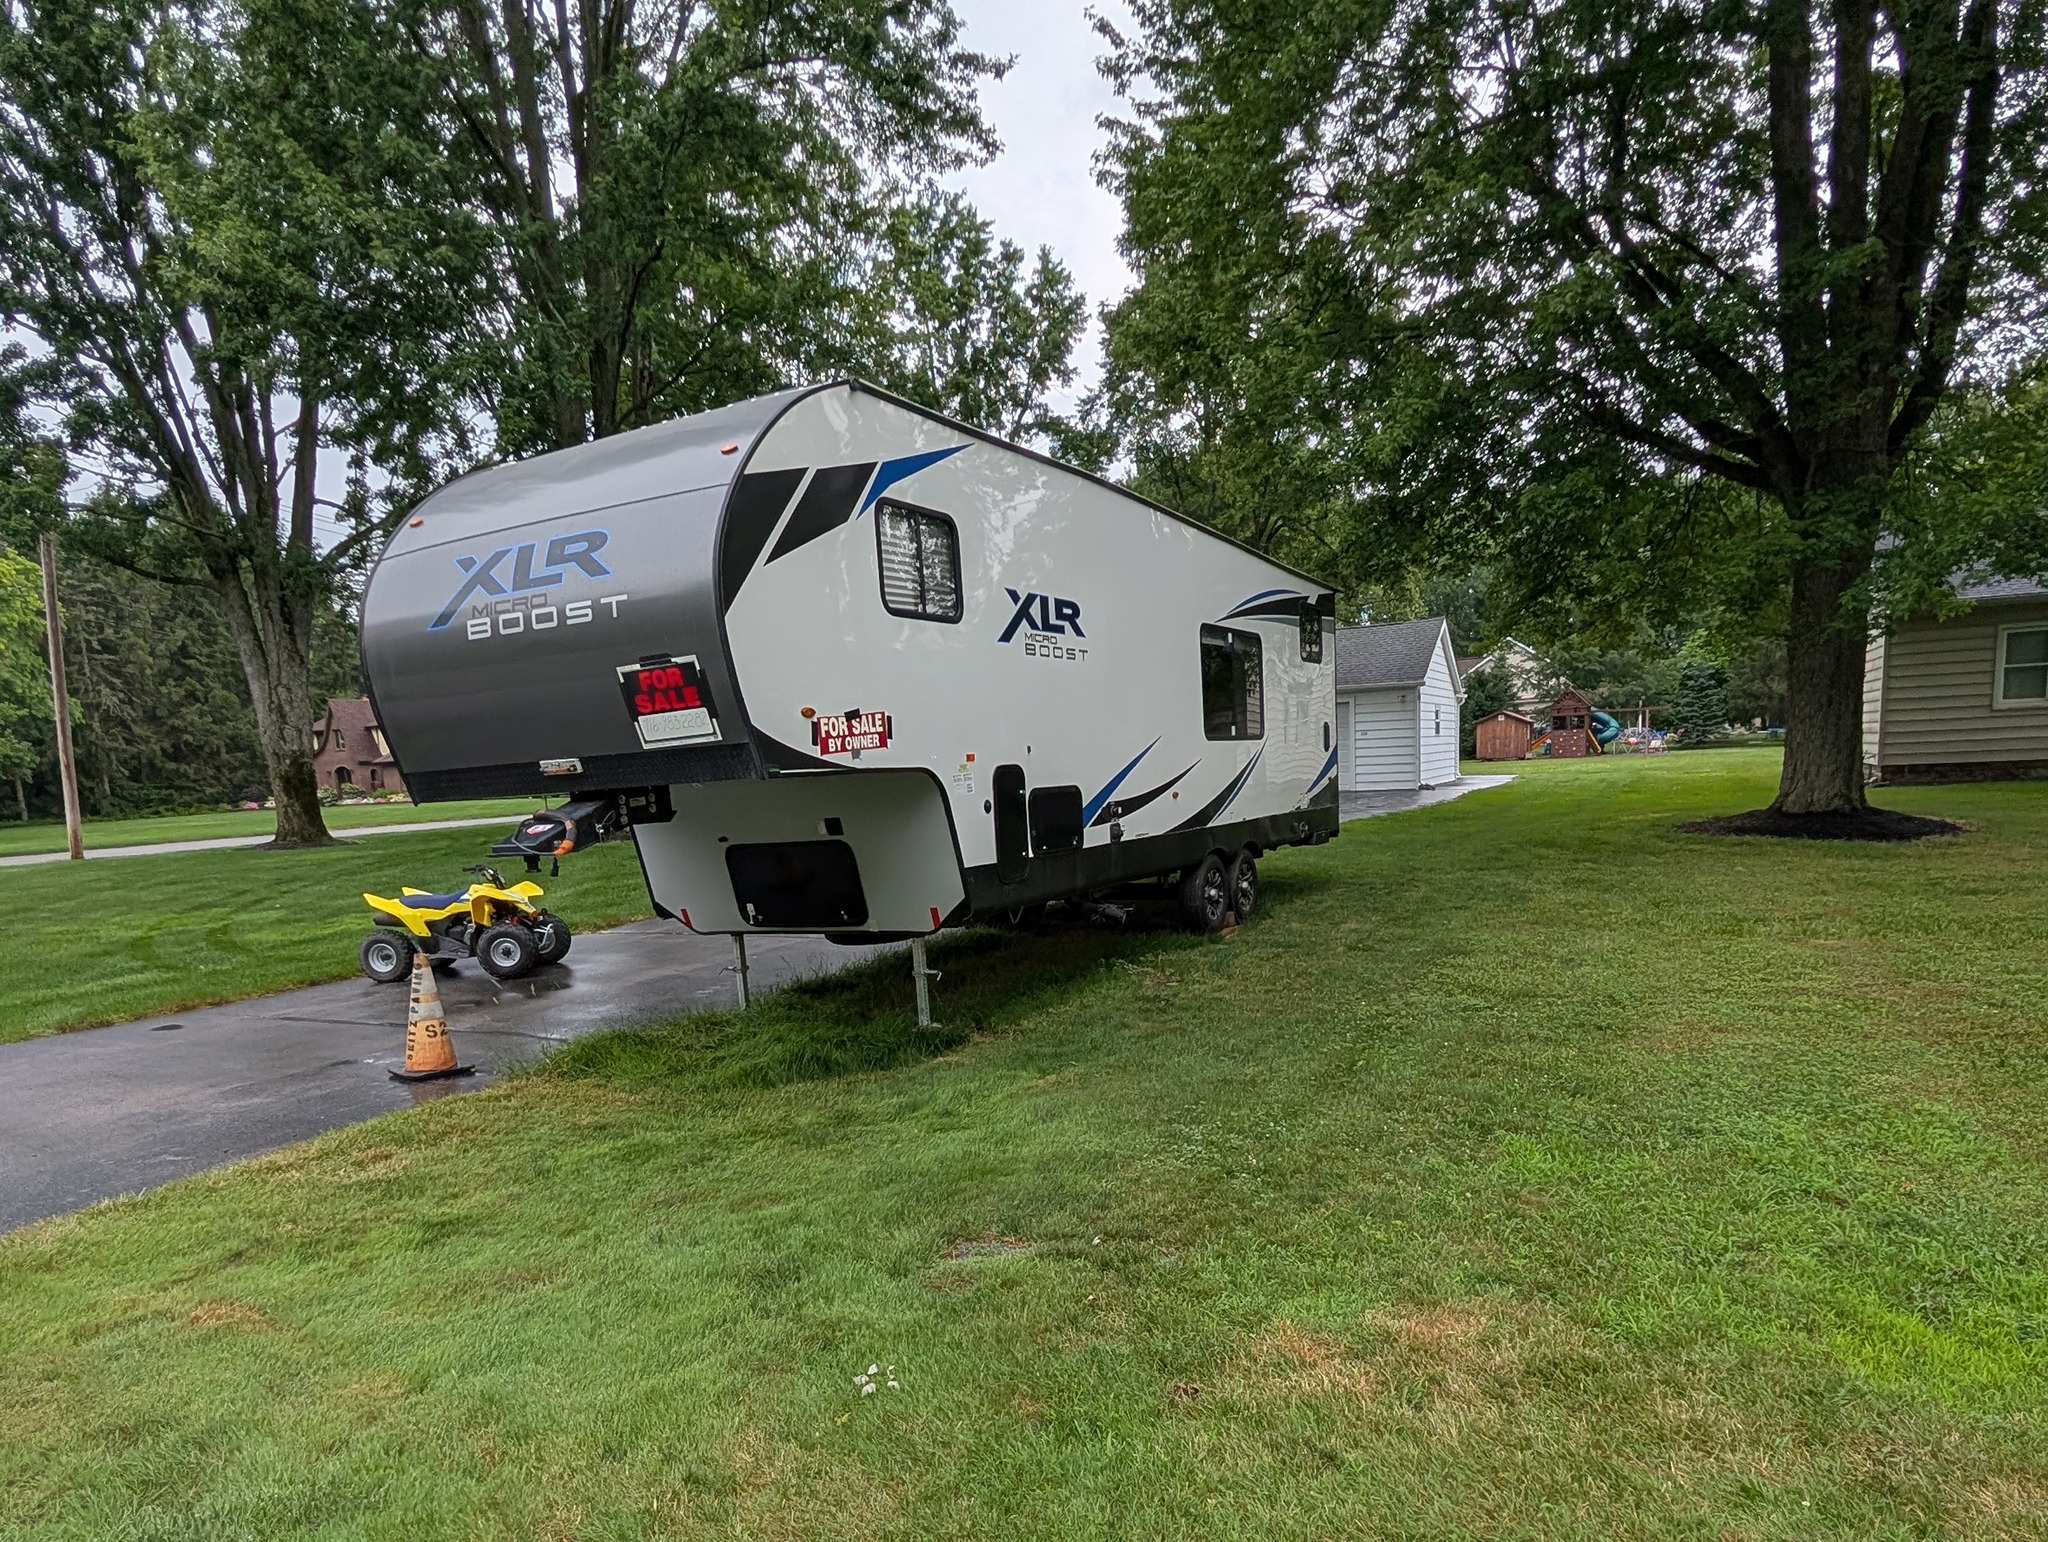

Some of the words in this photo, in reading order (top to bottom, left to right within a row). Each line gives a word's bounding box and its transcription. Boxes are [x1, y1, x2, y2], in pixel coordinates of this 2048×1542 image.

[427, 528, 613, 632] XLR
[466, 594, 628, 641] BOOST
[472, 592, 548, 618] MICRO
[997, 587, 1086, 643] XLR
[1024, 632, 1057, 645] MICRO
[1025, 642, 1088, 661] BOOST
[638, 667, 684, 691] FOR
[634, 686, 702, 713] SALE
[819, 716, 849, 738] FOR
[851, 713, 884, 735] SALE
[828, 738, 842, 752] BY
[845, 734, 880, 750] OWNER
